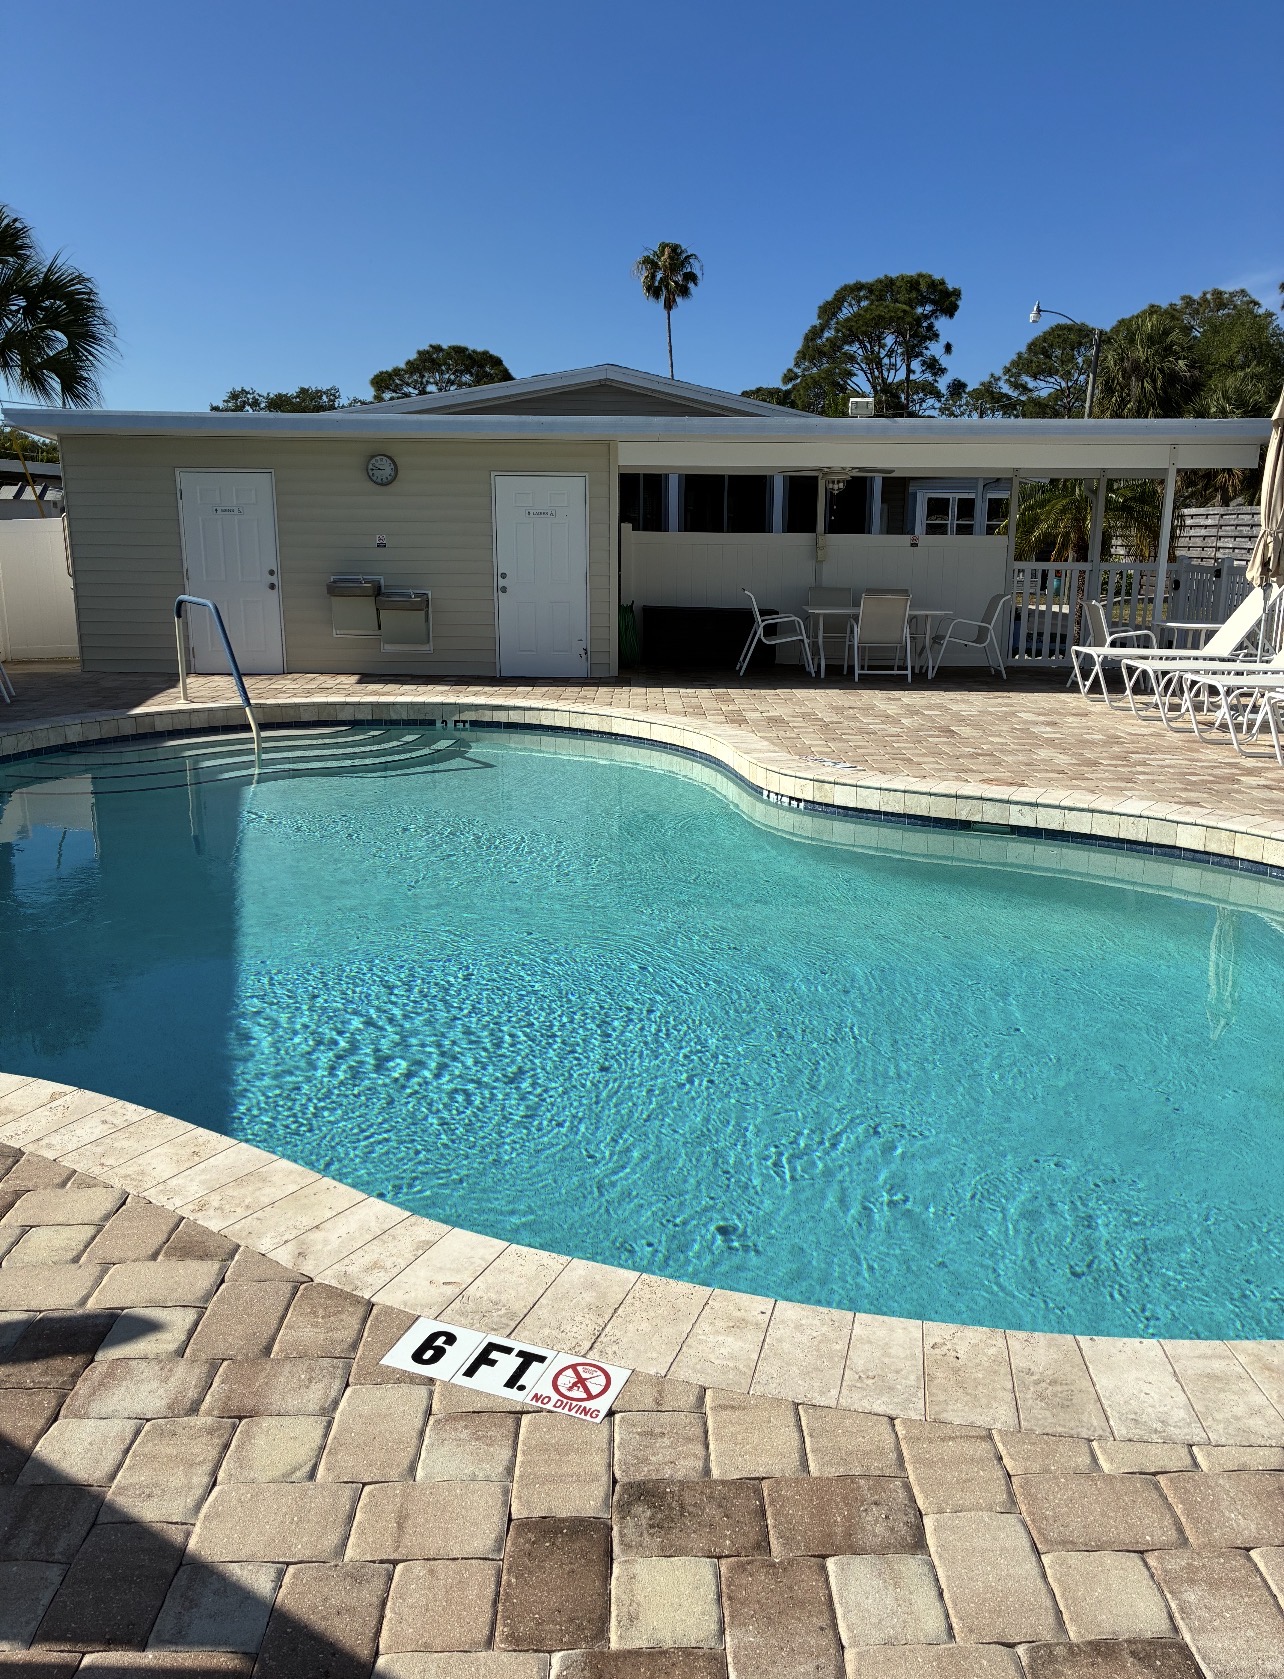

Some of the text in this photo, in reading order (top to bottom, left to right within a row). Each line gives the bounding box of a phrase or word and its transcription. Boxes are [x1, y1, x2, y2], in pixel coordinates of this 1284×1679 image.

[411, 1331, 549, 1391] 6 FT.
[530, 1392, 601, 1419] NO DIVING
